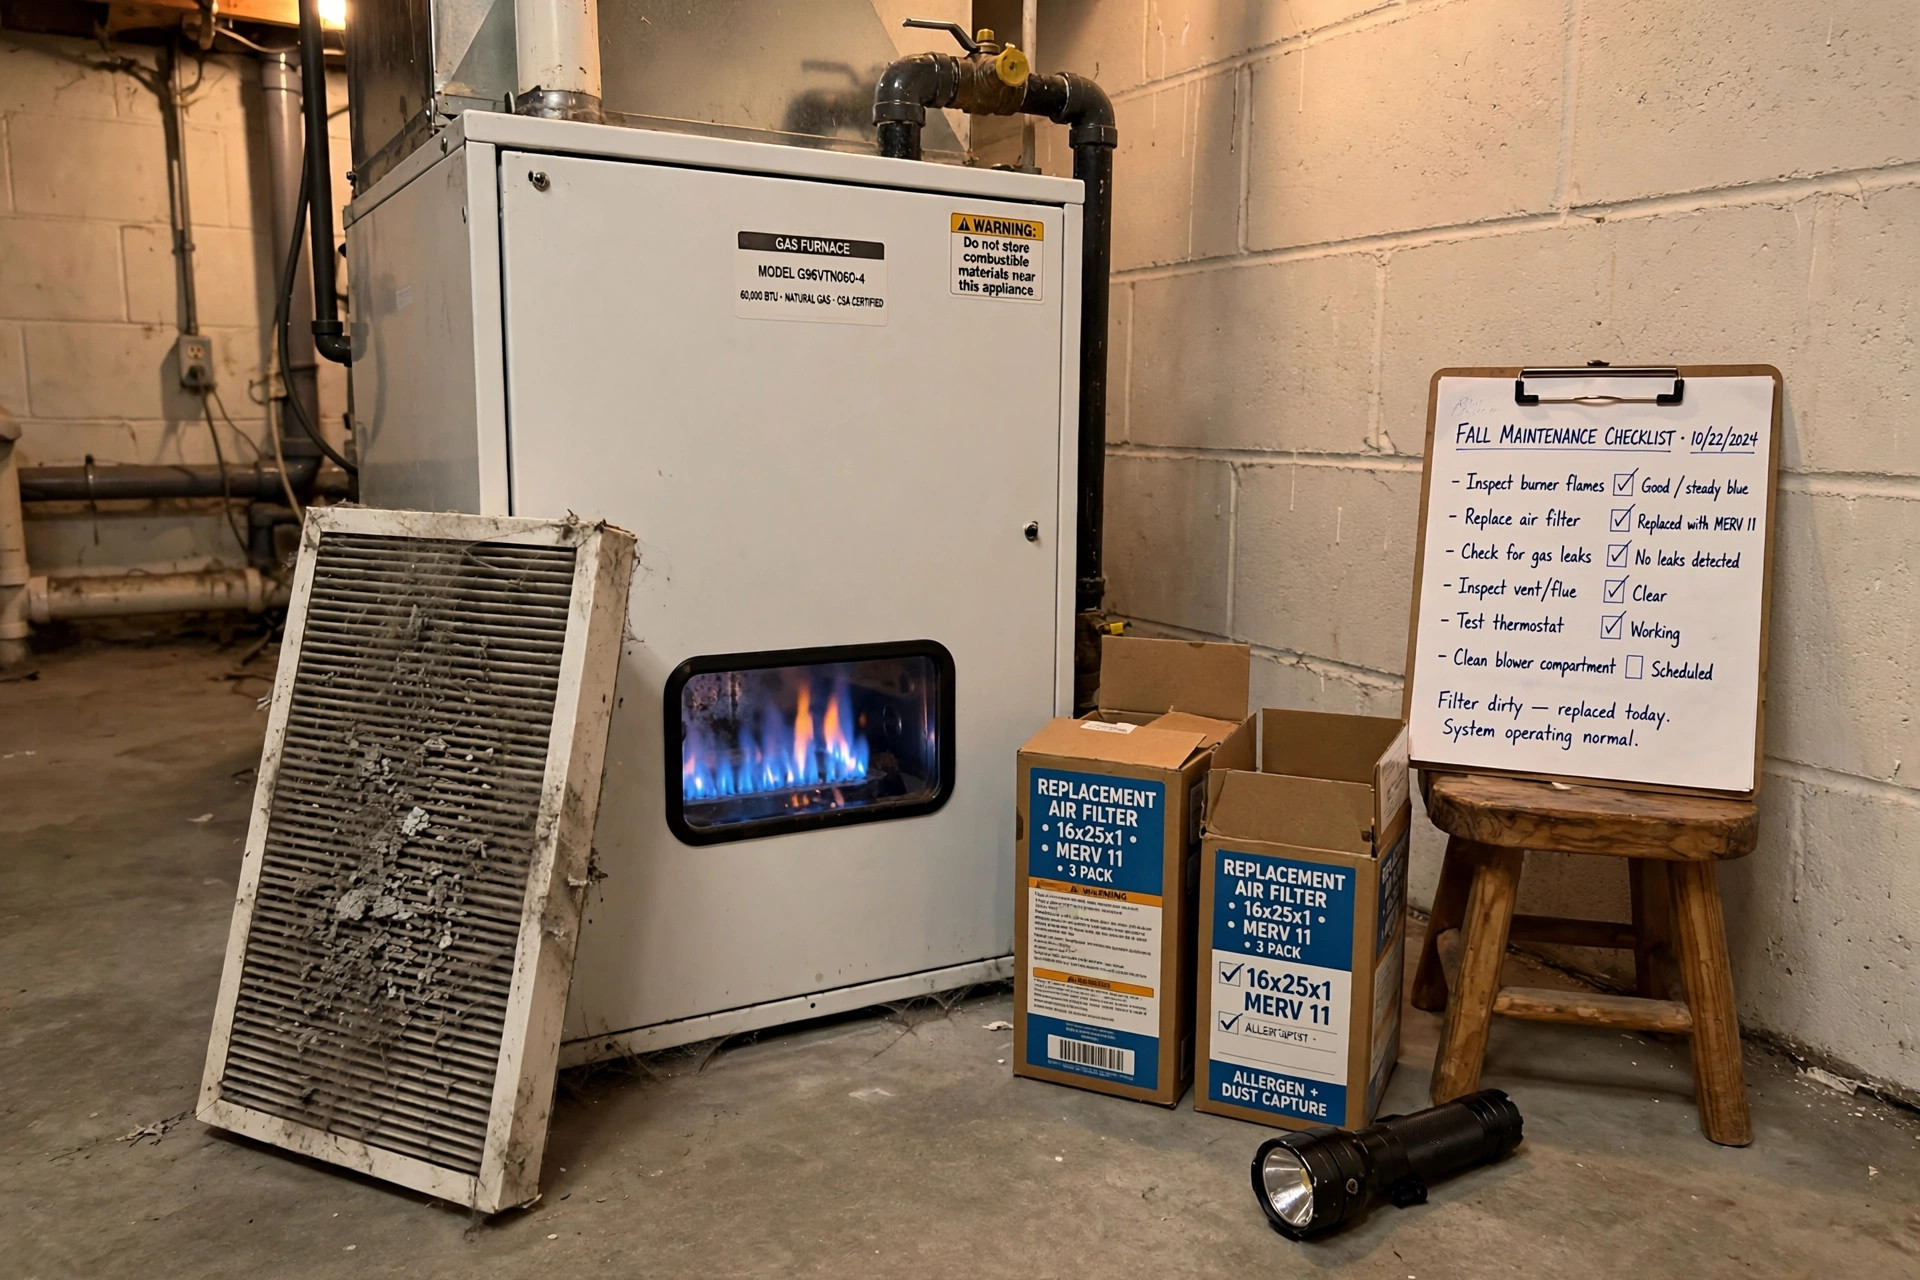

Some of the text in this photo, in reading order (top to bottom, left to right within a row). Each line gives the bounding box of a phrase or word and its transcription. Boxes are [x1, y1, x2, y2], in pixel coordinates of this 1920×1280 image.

[973, 218, 1036, 238] WARNING:
[775, 237, 850, 254] GAS FURNACE
[964, 236, 1030, 253] Do not store
[963, 252, 1029, 267] combustible
[758, 265, 795, 279] MODEL
[958, 266, 1036, 282] materials near
[740, 290, 884, 308] 60,000 BTU NATURAL GAS CSA CERTIFIED
[958, 279, 1034, 296] this appliance
[1456, 422, 1758, 451] FALL MAINTENANCE CHECKLIST 10/22/2024
[1466, 472, 1605, 495] Inspect burner flames
[1641, 477, 1670, 494] Good
[1686, 478, 1721, 501] steady
[1726, 478, 1749, 496] blue
[1465, 507, 1581, 530] Replace air filter
[1637, 512, 1682, 536] Replaced
[1687, 514, 1709, 530] with
[1714, 516, 1744, 532] MERV
[1461, 542, 1592, 568] Check for gas leaks
[1634, 550, 1740, 569] No leaks detected
[1458, 577, 1578, 602] Inspect vent/flue
[1632, 584, 1668, 602] Clear
[1456, 612, 1565, 634] Test thermostat
[1630, 620, 1680, 648] Working
[1453, 648, 1616, 678] Clean blower compartment
[1651, 661, 1714, 681] Scheduled
[1438, 690, 1479, 710] Filter
[1488, 694, 1524, 720] dirty
[1558, 700, 1616, 722] replaced
[1624, 702, 1670, 730] today.
[1442, 718, 1638, 750] System operating normal.
[1038, 778, 1156, 808] REPLACEMENT
[1048, 800, 1138, 828] AIR FILTER
[1057, 822, 1122, 846] 16x25x1
[1056, 842, 1122, 868] MERV 11
[1068, 864, 1113, 882] 3 PACK
[1224, 858, 1346, 891] REPLACEMENT
[1234, 880, 1327, 908] AIR FILTER
[1244, 900, 1310, 926] 16x25x1
[1243, 919, 1311, 945] MERV 11
[1256, 940, 1301, 959] 3 PACK
[1247, 967, 1331, 1002] 16x25x1
[1244, 992, 1330, 1026] MERV 11
[1233, 1070, 1304, 1097] ALLERGEN
[1222, 1082, 1327, 1117] DUST CAPTURE
